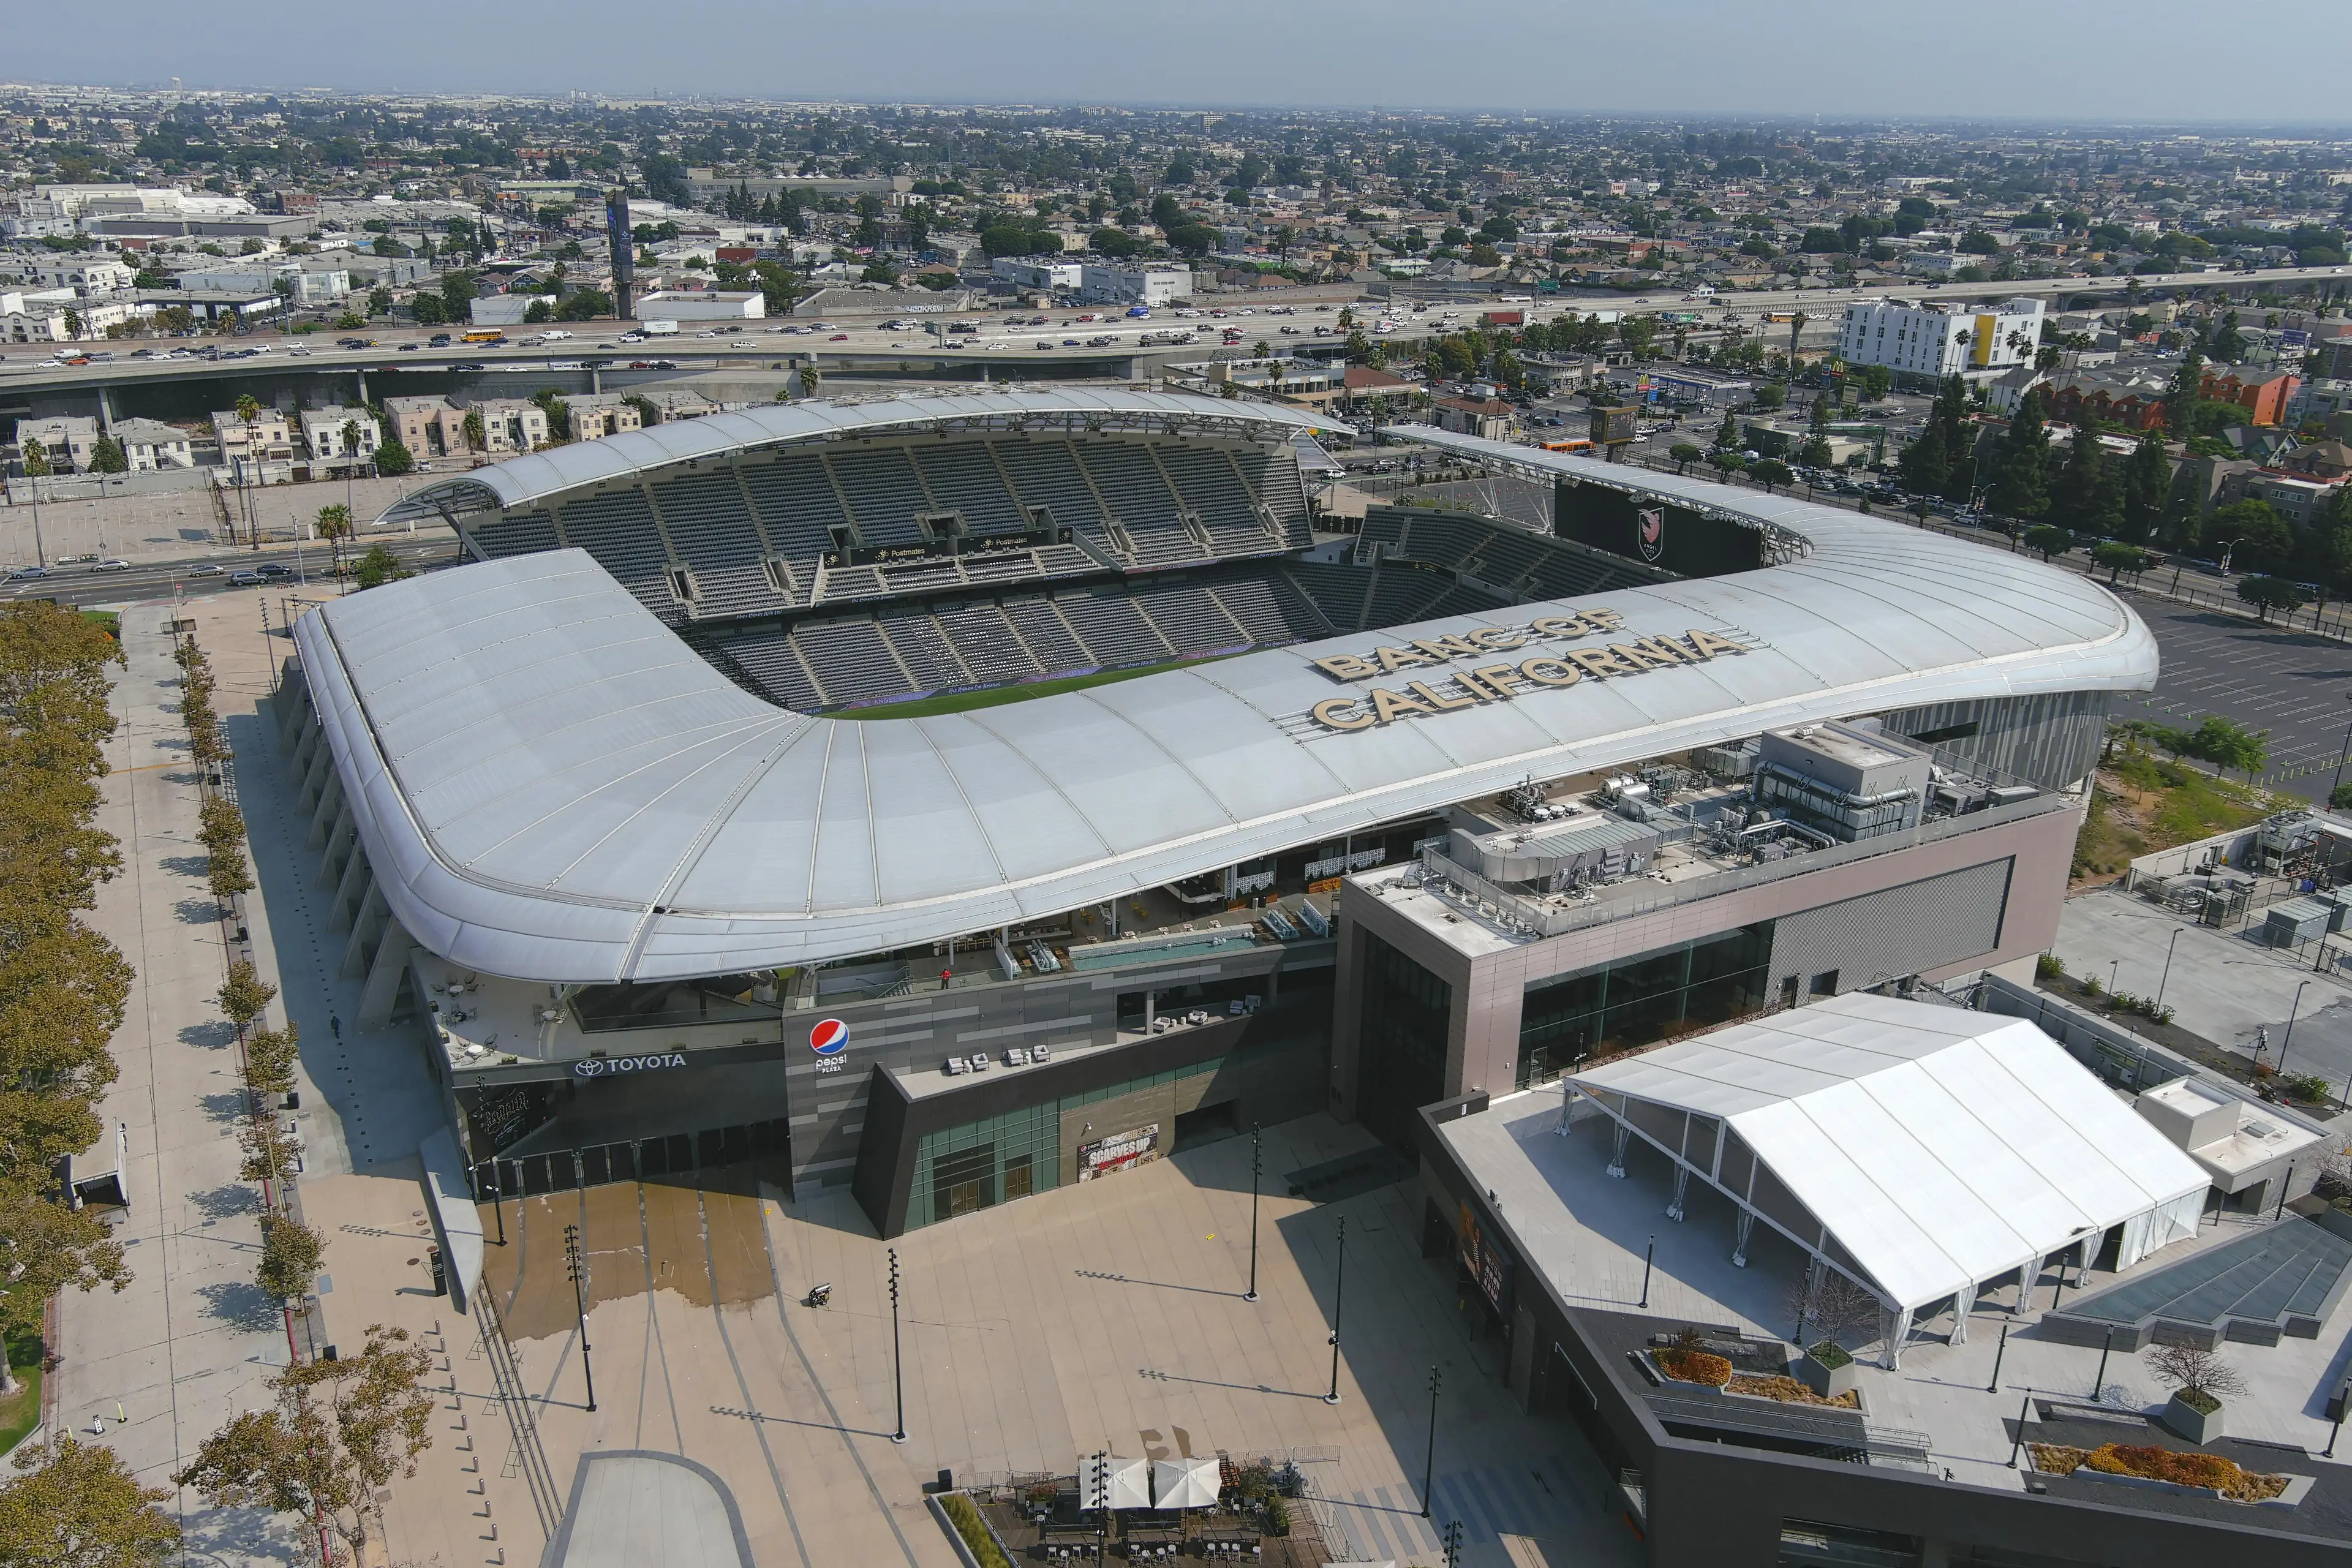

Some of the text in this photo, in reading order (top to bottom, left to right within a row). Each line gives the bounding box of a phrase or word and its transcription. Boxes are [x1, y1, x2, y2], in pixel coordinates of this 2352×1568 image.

[996, 537, 1027, 545] Postmates
[891, 548, 925, 557] Postmates
[1313, 607, 1623, 680] BANC OF
[1312, 629, 1754, 729] CALIFORNIA
[606, 1054, 687, 1072] TOYOTA
[816, 1054, 847, 1069] pepsi
[1087, 1142, 1100, 1150] pepsi
[1089, 1137, 1150, 1166] SCARVES UP
